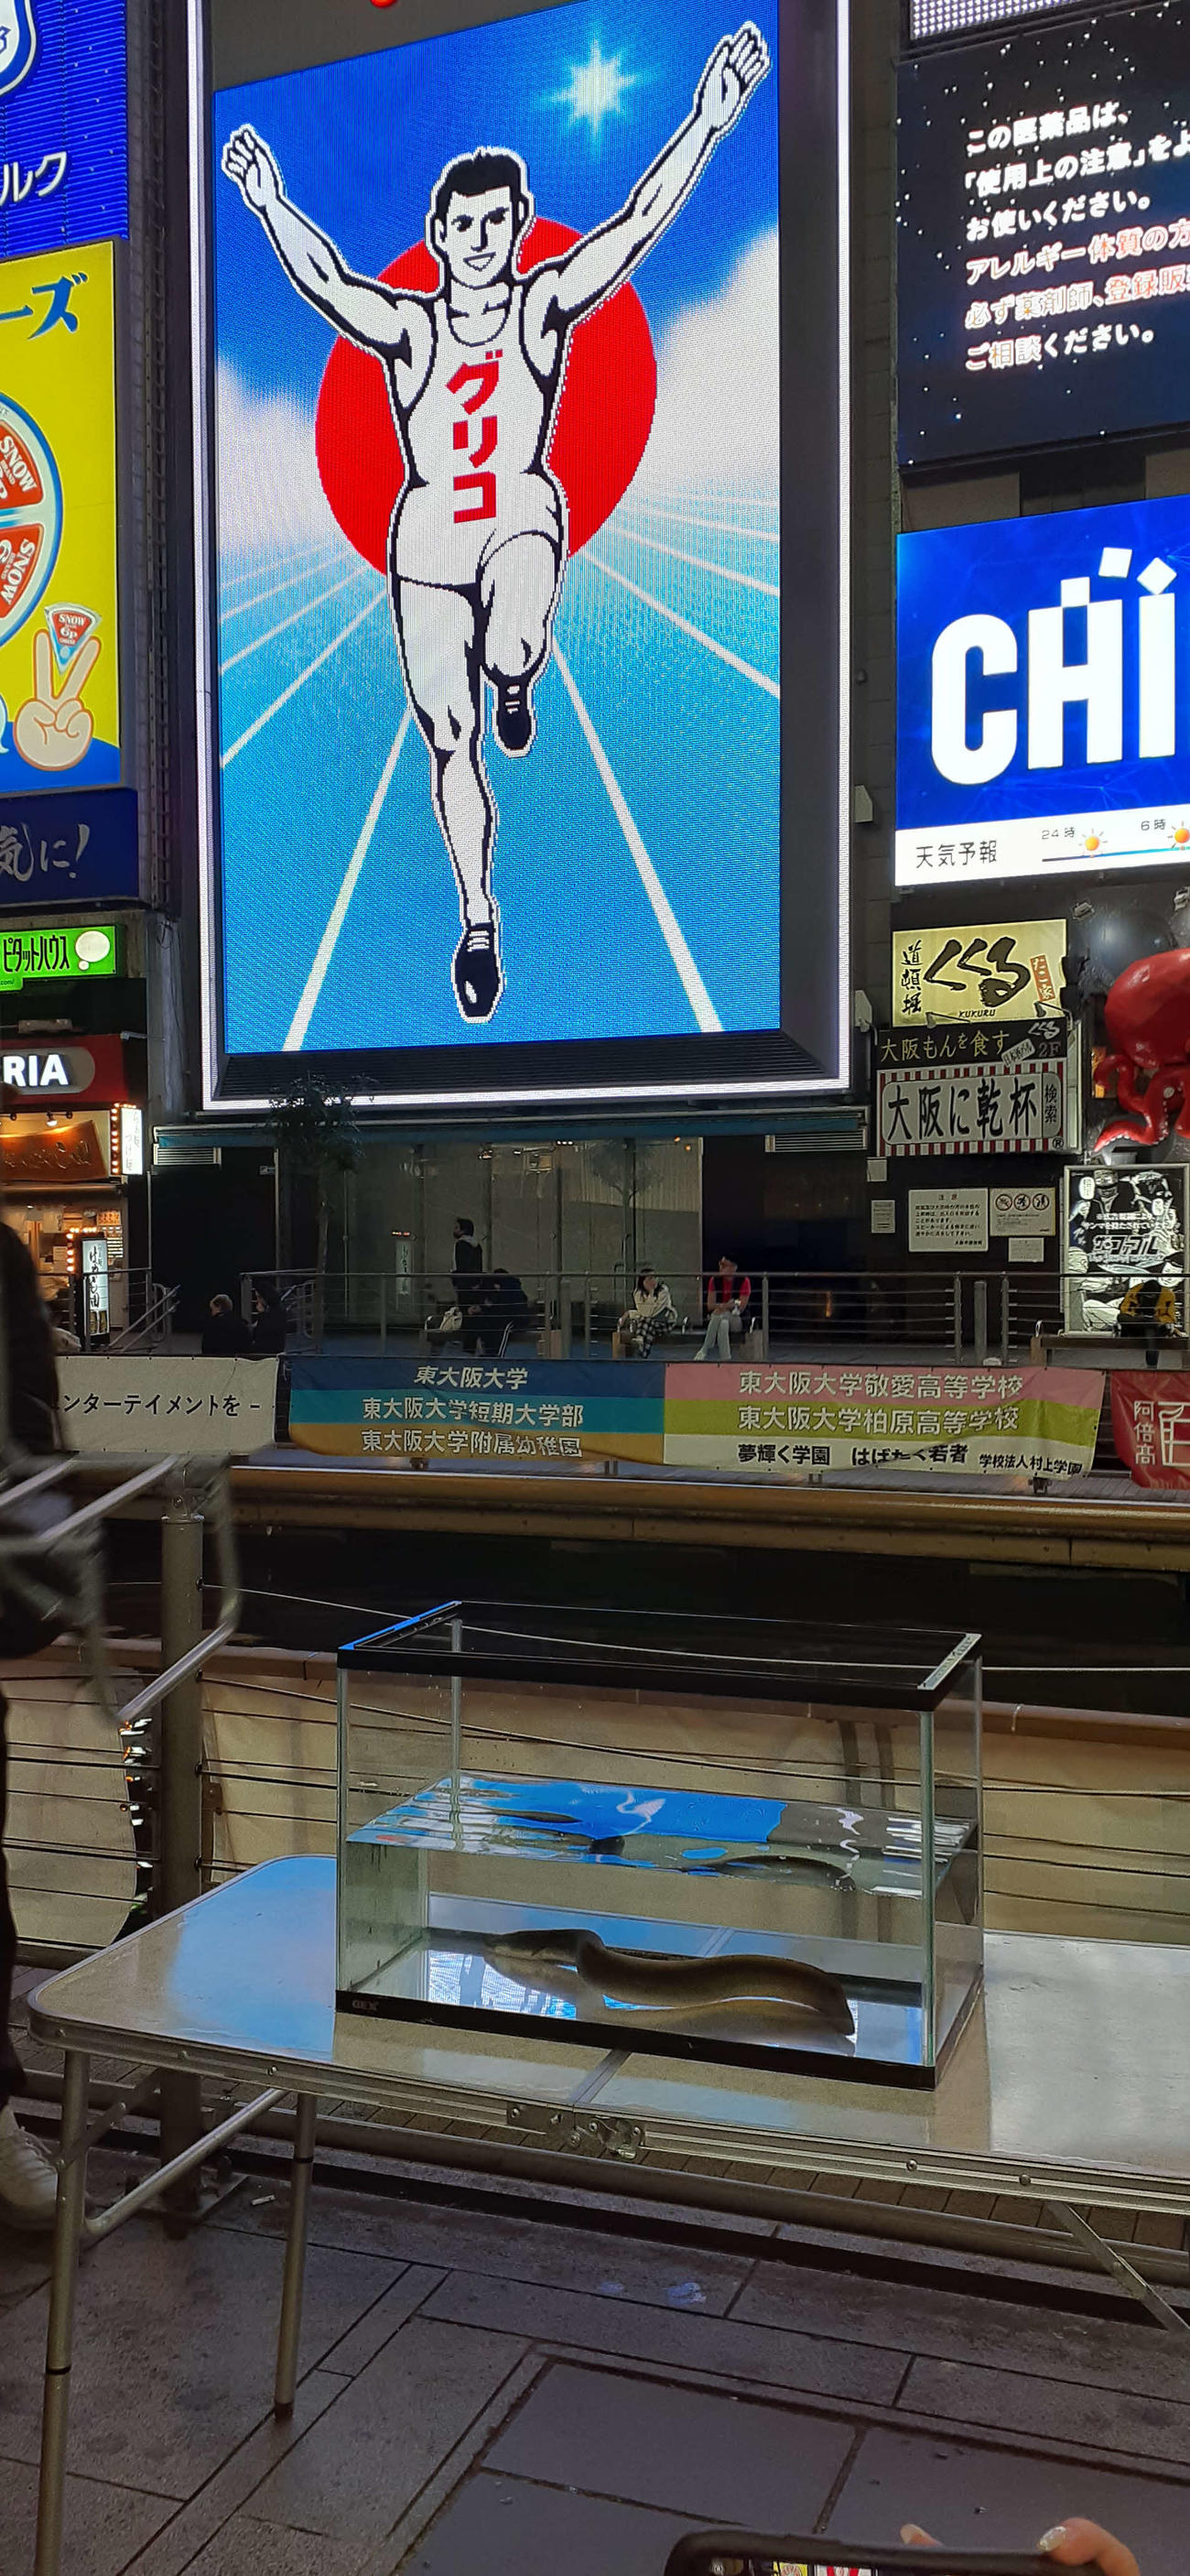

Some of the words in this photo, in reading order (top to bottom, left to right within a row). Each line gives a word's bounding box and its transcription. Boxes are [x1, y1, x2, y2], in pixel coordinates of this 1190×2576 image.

[967, 101, 1130, 153] この医薬品は、
[966, 190, 1151, 242] お使いください。
[965, 264, 1190, 330] 必ず薬剤師、登録販
[965, 322, 1154, 372] ご相談ください。
[444, 348, 503, 524] グリコ
[0, 436, 38, 493] SNOW
[1, 538, 36, 605] SNOW
[915, 840, 997, 869] 天気予報
[3, 934, 70, 973] ピタットハウス
[902, 940, 924, 1015] 道頓堀
[958, 1008, 996, 1018] KUKURU
[880, 1029, 1010, 1063] 大阪もんを食す
[1038, 1041, 1061, 1058] 2F
[3, 1053, 70, 1087] RIA
[887, 1078, 1037, 1142] 大阪に乾杯
[1044, 1083, 1057, 1124] 検索
[414, 1364, 528, 1391] 東大阪大学
[738, 1370, 1023, 1400] 東大阪大学敬愛高等学校
[63, 1392, 241, 1417] ンターテイメントを
[362, 1397, 584, 1429] 東大阪大学短期大学部
[738, 1406, 1019, 1436] 東大阪大学柏原高等学校
[362, 1429, 583, 1458] 東大阪大学附属幼稚園
[738, 1443, 830, 1466] 夢輝く学園
[979, 1453, 1083, 1477] 学校法人村上学園
